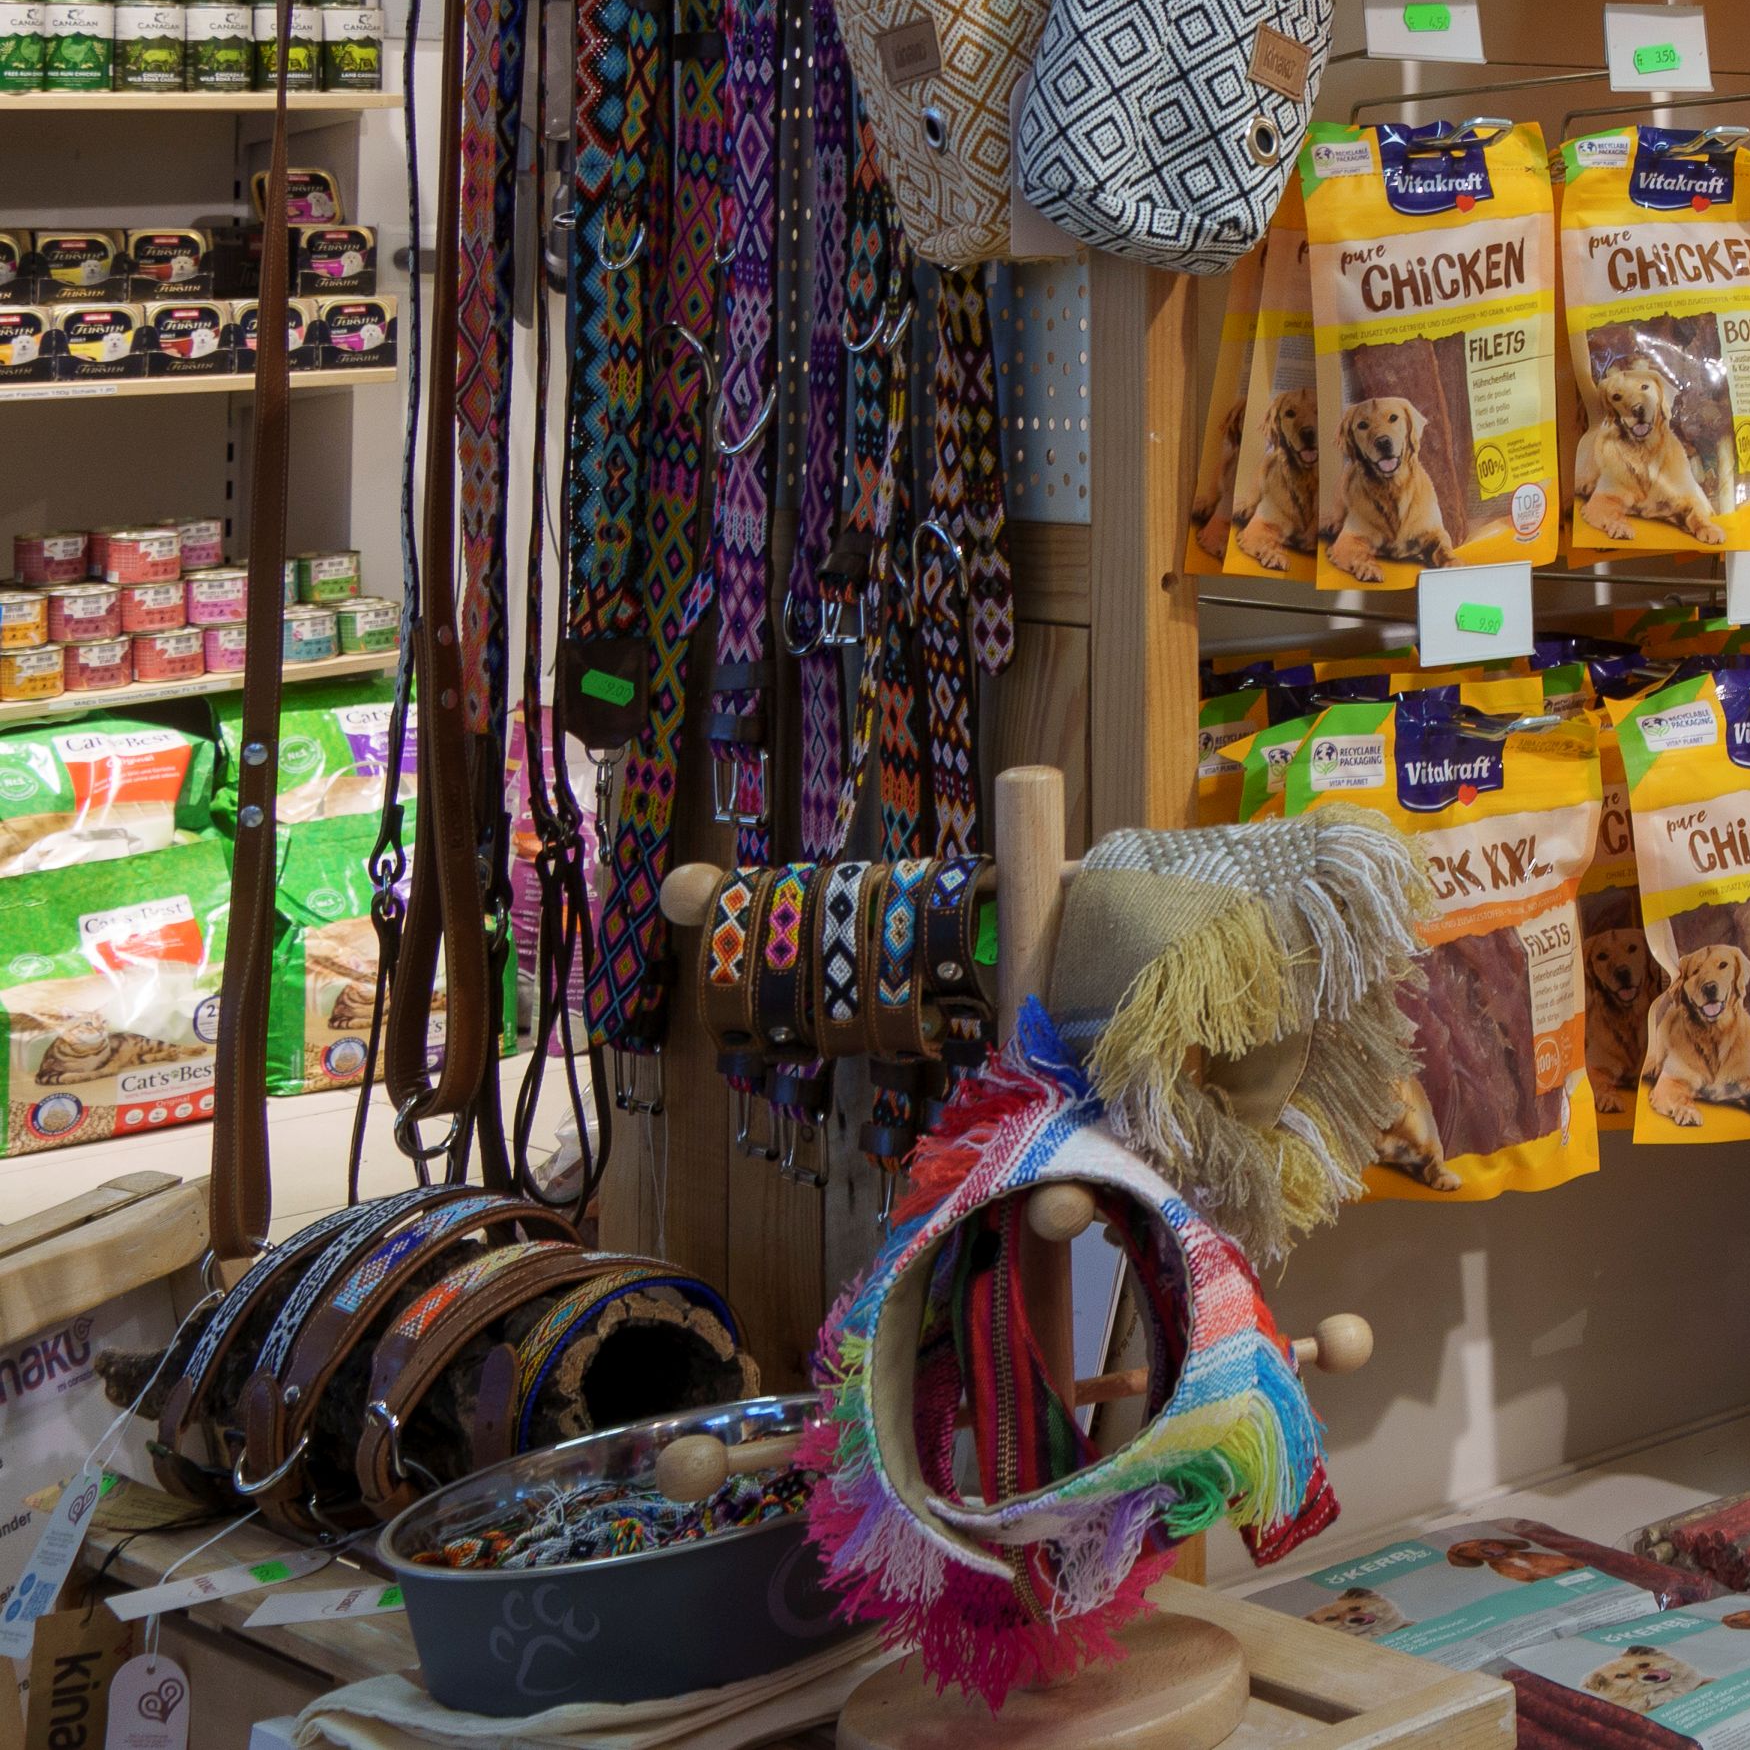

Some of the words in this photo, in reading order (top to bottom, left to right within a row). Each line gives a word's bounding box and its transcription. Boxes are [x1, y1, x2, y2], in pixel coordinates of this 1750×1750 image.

[52, 18, 98, 27] CANAGAN
[1656, 49, 1676, 64] 3.50
[1398, 173, 1484, 195] Vitakraft
[1639, 171, 1729, 195] Vitakraft
[1588, 228, 1632, 259] pure
[1340, 242, 1386, 276] pure
[1478, 455, 1505, 480] 100%
[1479, 616, 1500, 631] 9.90
[1338, 745, 1383, 759] RECYCLABLE
[1338, 754, 1383, 769] PACKAGING
[1404, 754, 1497, 789] Vitakraft
[1665, 809, 1707, 841] pure
[1486, 833, 1555, 902] XXL
[120, 1066, 170, 1094] Cat's
[0, 1316, 94, 1408] naku
